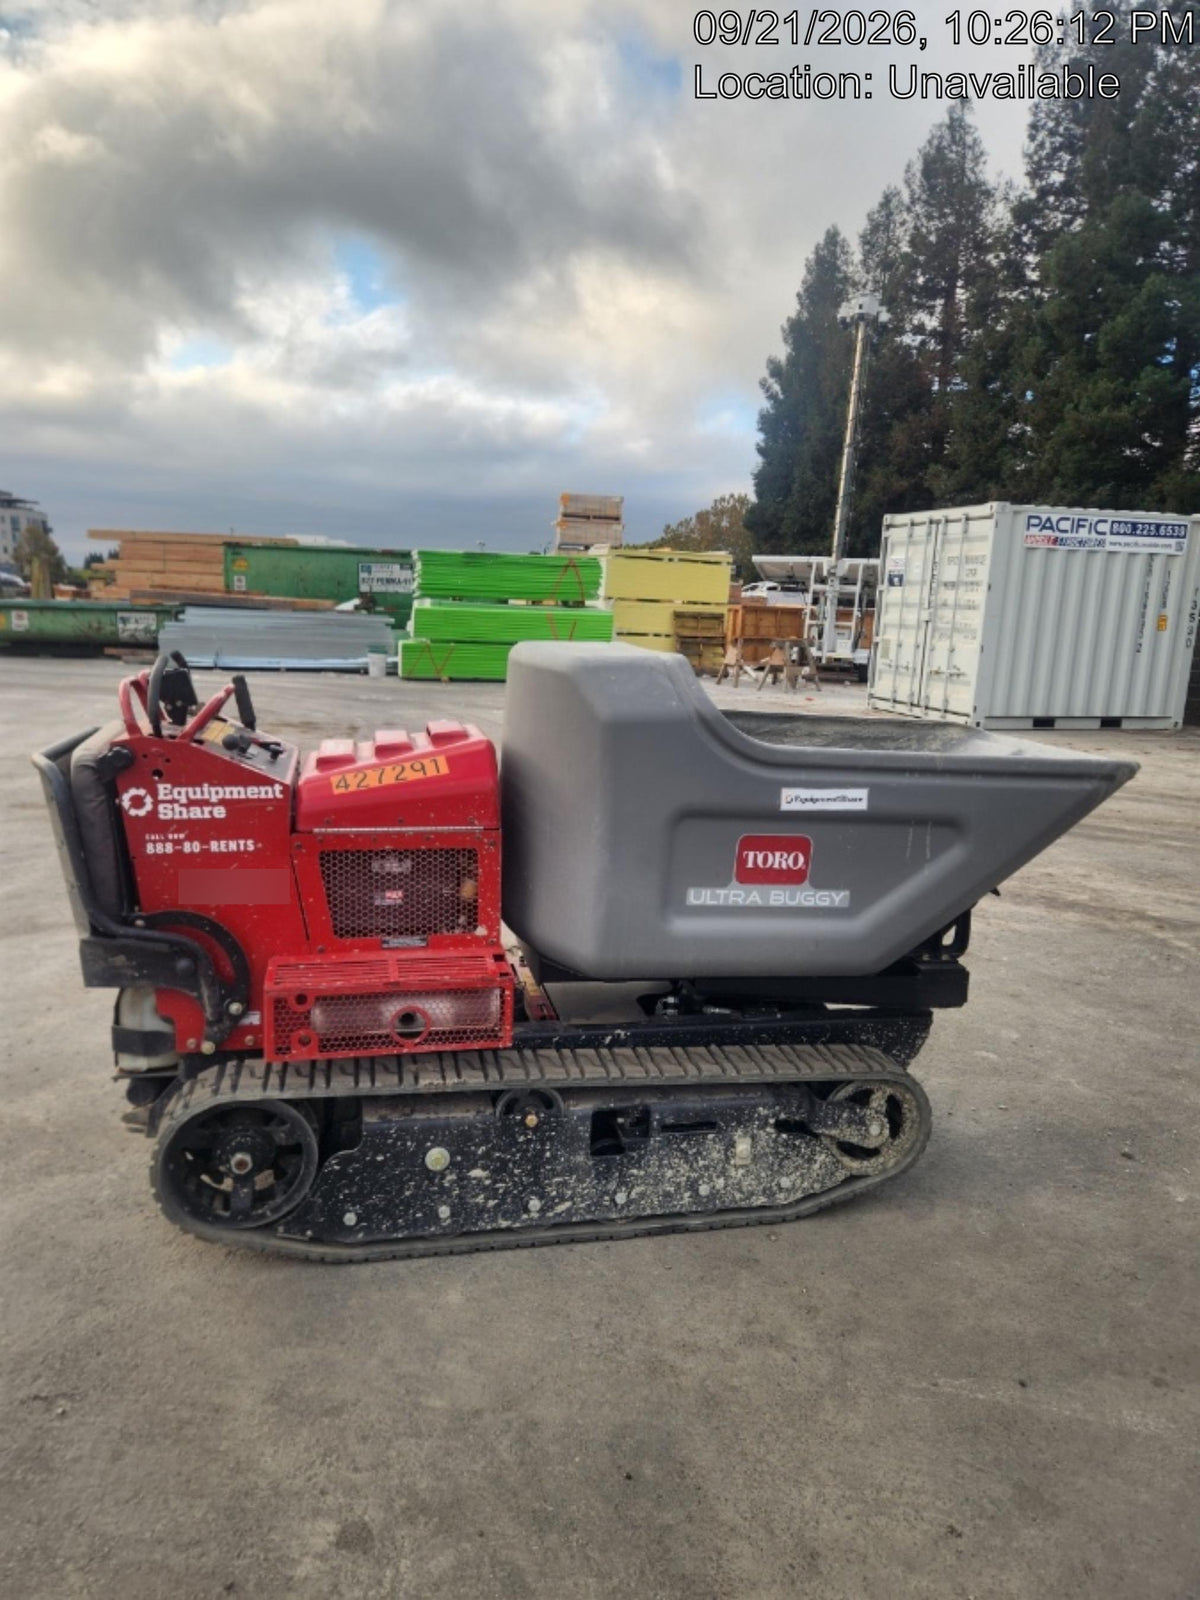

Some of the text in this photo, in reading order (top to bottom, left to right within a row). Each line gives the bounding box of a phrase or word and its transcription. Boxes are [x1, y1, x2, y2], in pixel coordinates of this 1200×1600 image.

[334, 757, 444, 791] 427291
[157, 783, 283, 801] Equipment
[158, 802, 226, 819] Share
[146, 840, 255, 854] 888-80-RENTS
[743, 850, 805, 870] TORO
[689, 890, 846, 906] ULTRA BUGGY
